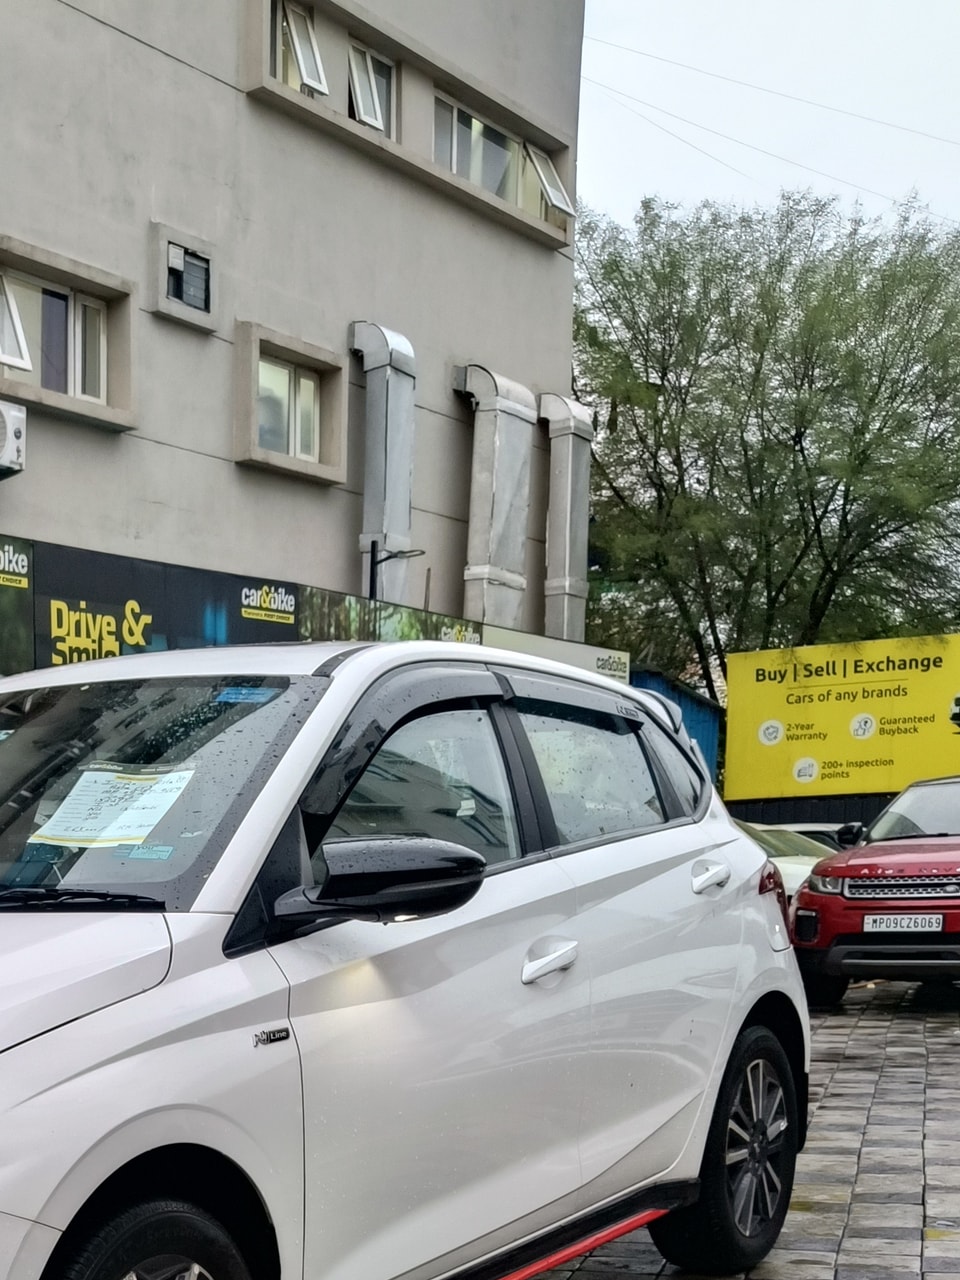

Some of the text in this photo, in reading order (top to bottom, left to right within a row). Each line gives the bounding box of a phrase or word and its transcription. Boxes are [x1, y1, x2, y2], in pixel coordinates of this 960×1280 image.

[242, 585, 296, 612] car&bike
[50, 599, 153, 646] Drive &
[51, 636, 117, 665] Smil
[755, 667, 788, 684] Buy
[803, 661, 837, 678] Sell
[853, 656, 944, 675] Exchange
[786, 684, 908, 705] Cars of any brands
[879, 714, 936, 726] Guaranteed
[786, 722, 815, 732] 2-Year
[879, 725, 919, 736] Buyback
[786, 732, 828, 742] Warranty
[821, 758, 895, 770] 200+ inspection
[821, 770, 850, 780] points
[871, 916, 942, 930] MP09CZ6069
